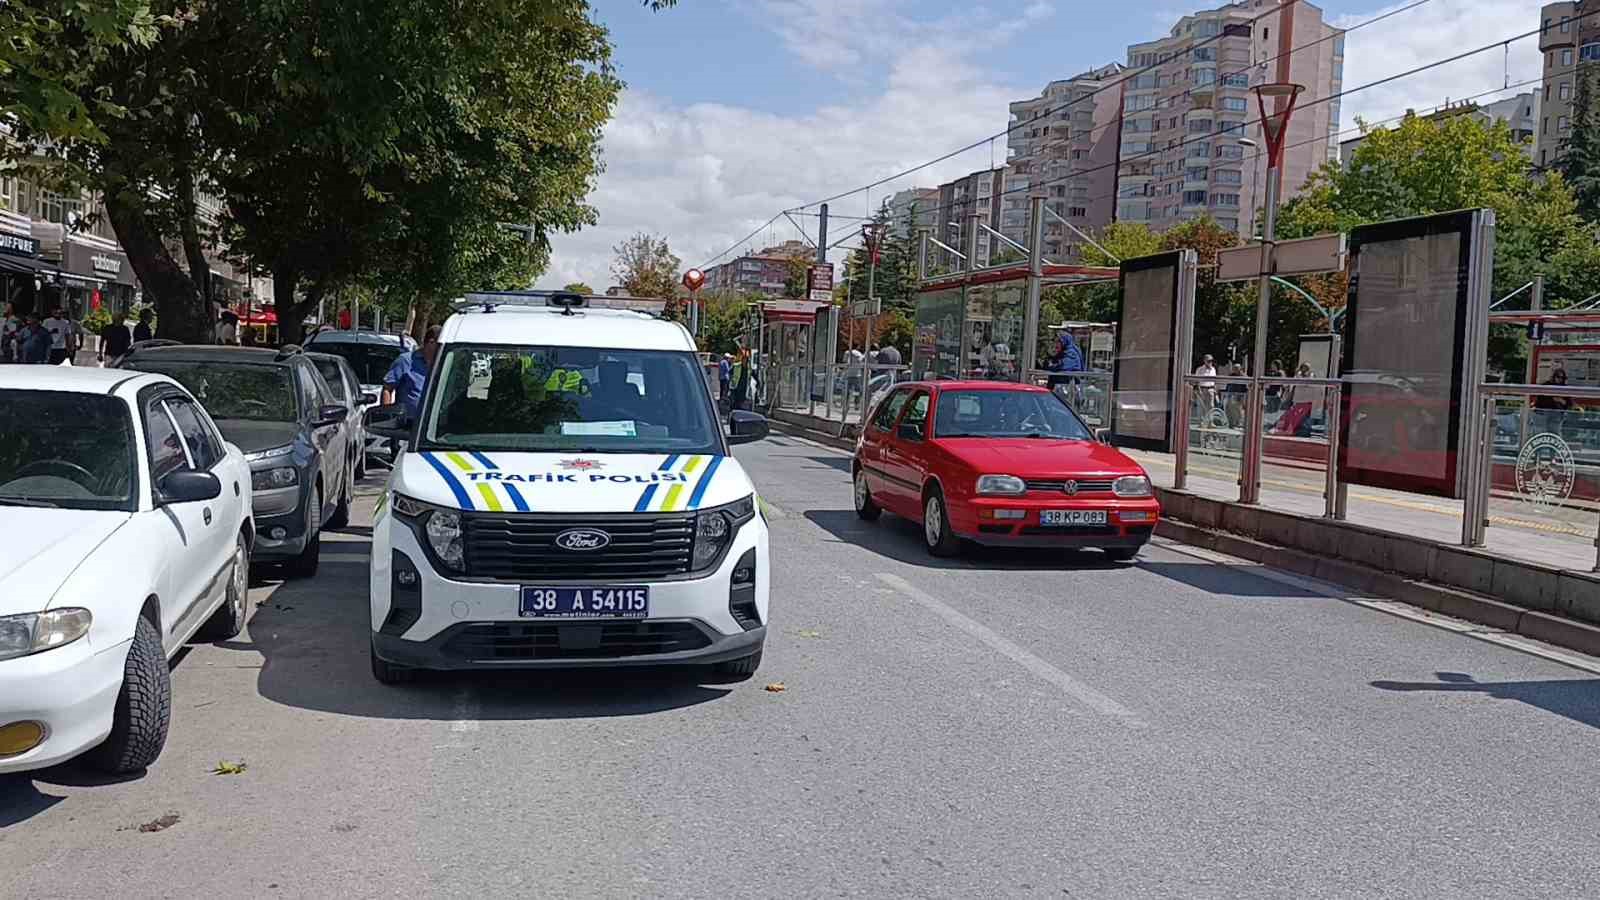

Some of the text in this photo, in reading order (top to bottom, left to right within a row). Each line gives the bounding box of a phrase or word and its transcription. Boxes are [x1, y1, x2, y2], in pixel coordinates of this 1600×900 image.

[466, 472, 687, 482] TRAFİK POLİSİ
[1047, 511, 1105, 522] 38 KP 083
[566, 532, 599, 547] Ford
[533, 590, 646, 610] 38 A 54115
